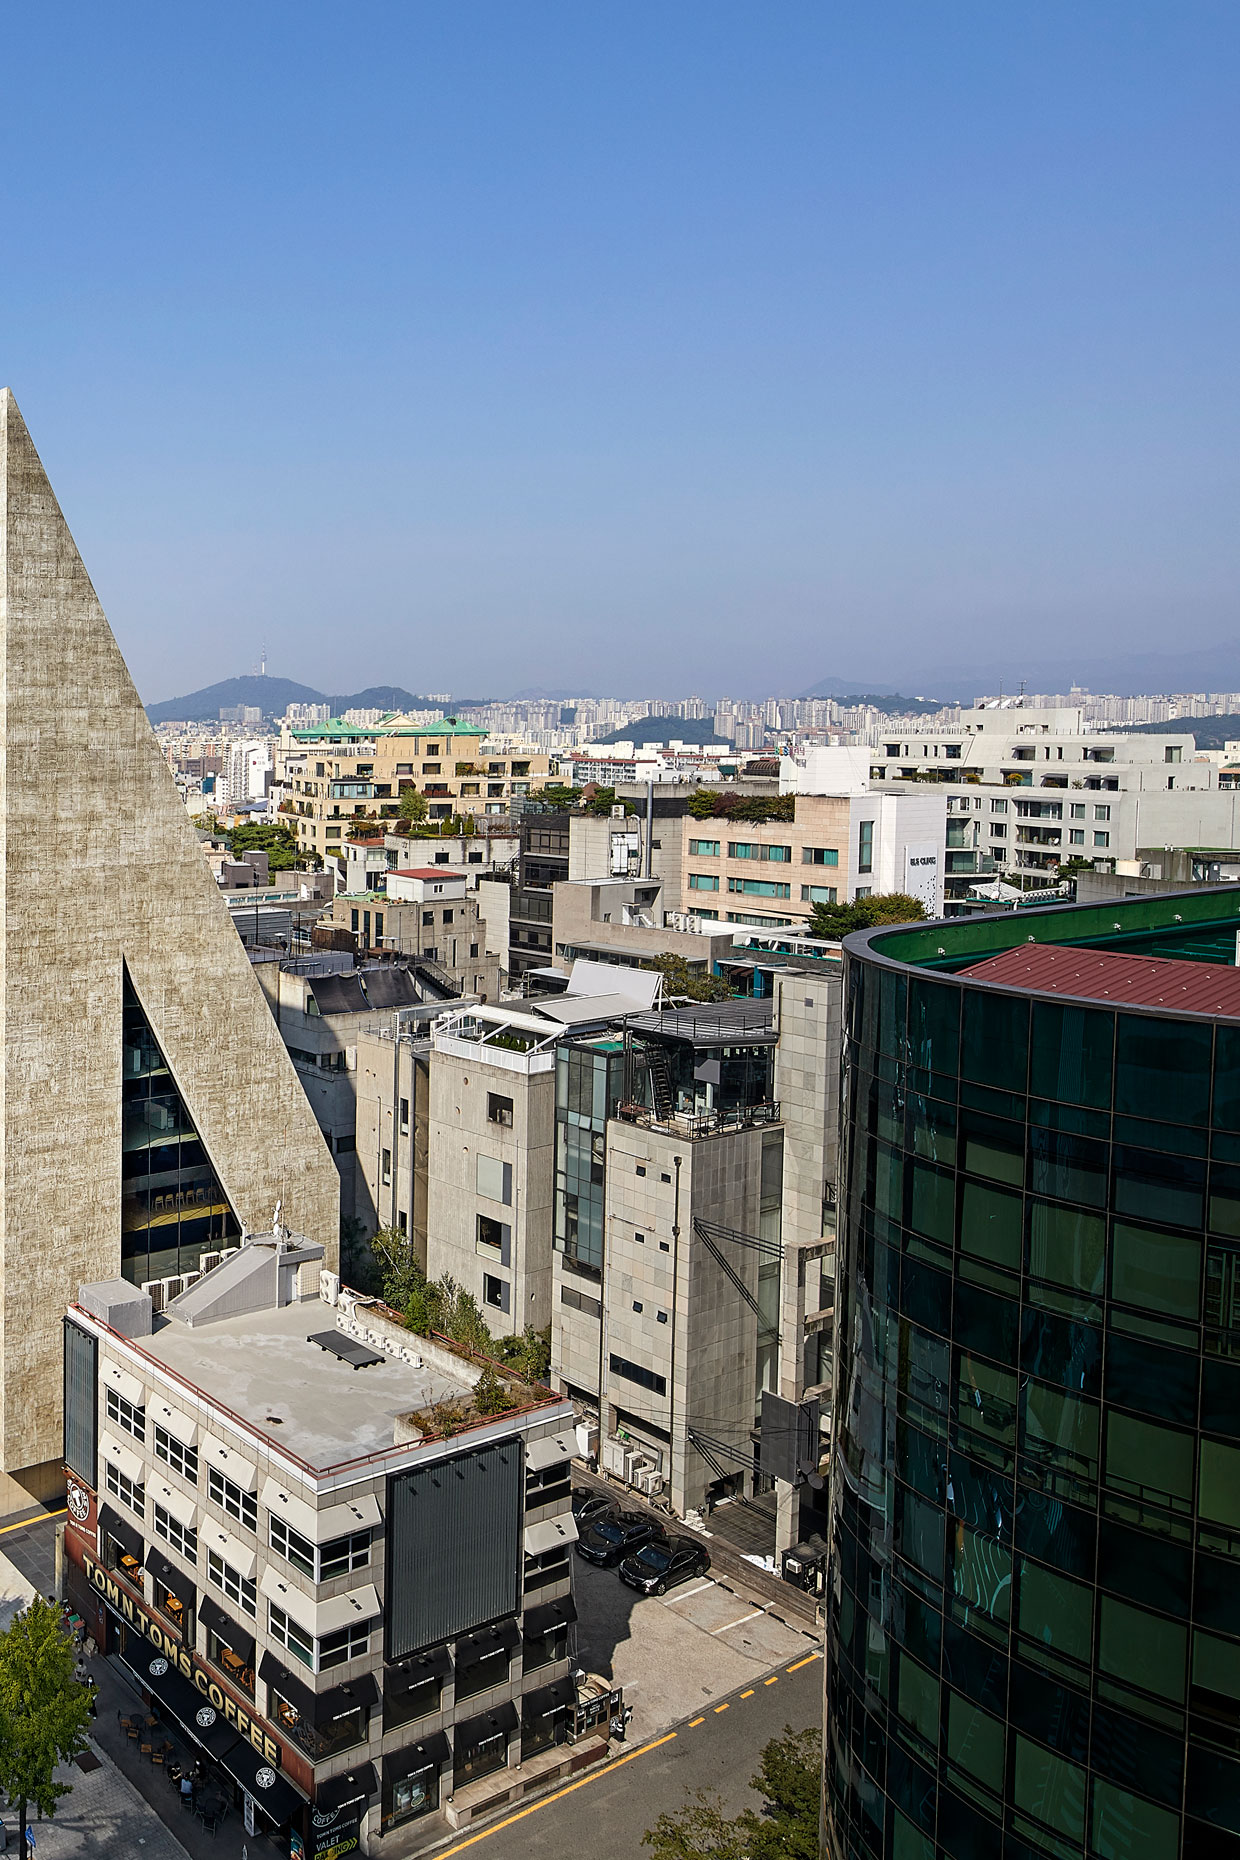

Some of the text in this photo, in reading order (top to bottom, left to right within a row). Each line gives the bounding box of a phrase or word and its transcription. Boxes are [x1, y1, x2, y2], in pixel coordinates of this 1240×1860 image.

[82, 1554, 118, 1604] TOM
[122, 1592, 133, 1620] N
[136, 1608, 192, 1679] TOMS
[194, 1670, 278, 1767] COFFEE
[316, 1835, 340, 1852] VALET
